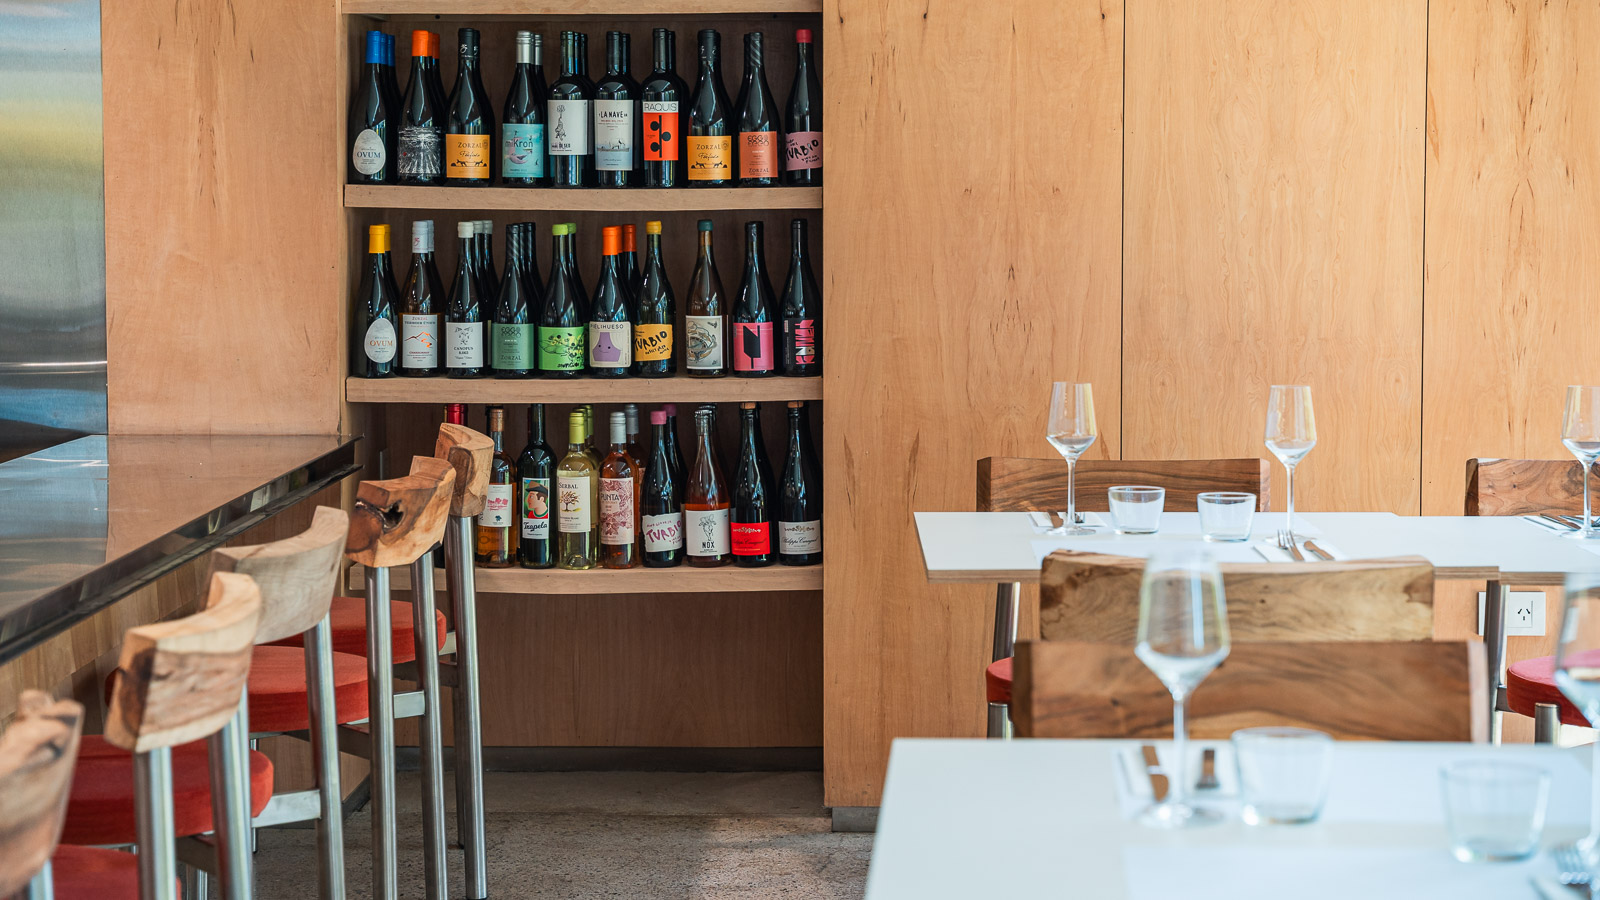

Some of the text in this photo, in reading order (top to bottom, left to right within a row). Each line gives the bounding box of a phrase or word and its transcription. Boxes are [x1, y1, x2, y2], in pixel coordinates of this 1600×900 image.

[643, 102, 677, 111] RAQUIS
[356, 151, 381, 159] OVUM
[635, 331, 668, 352] TURBIO
[600, 493, 619, 501] PUNTA
[646, 520, 682, 543] TURBIO
[701, 541, 715, 549] NOX
